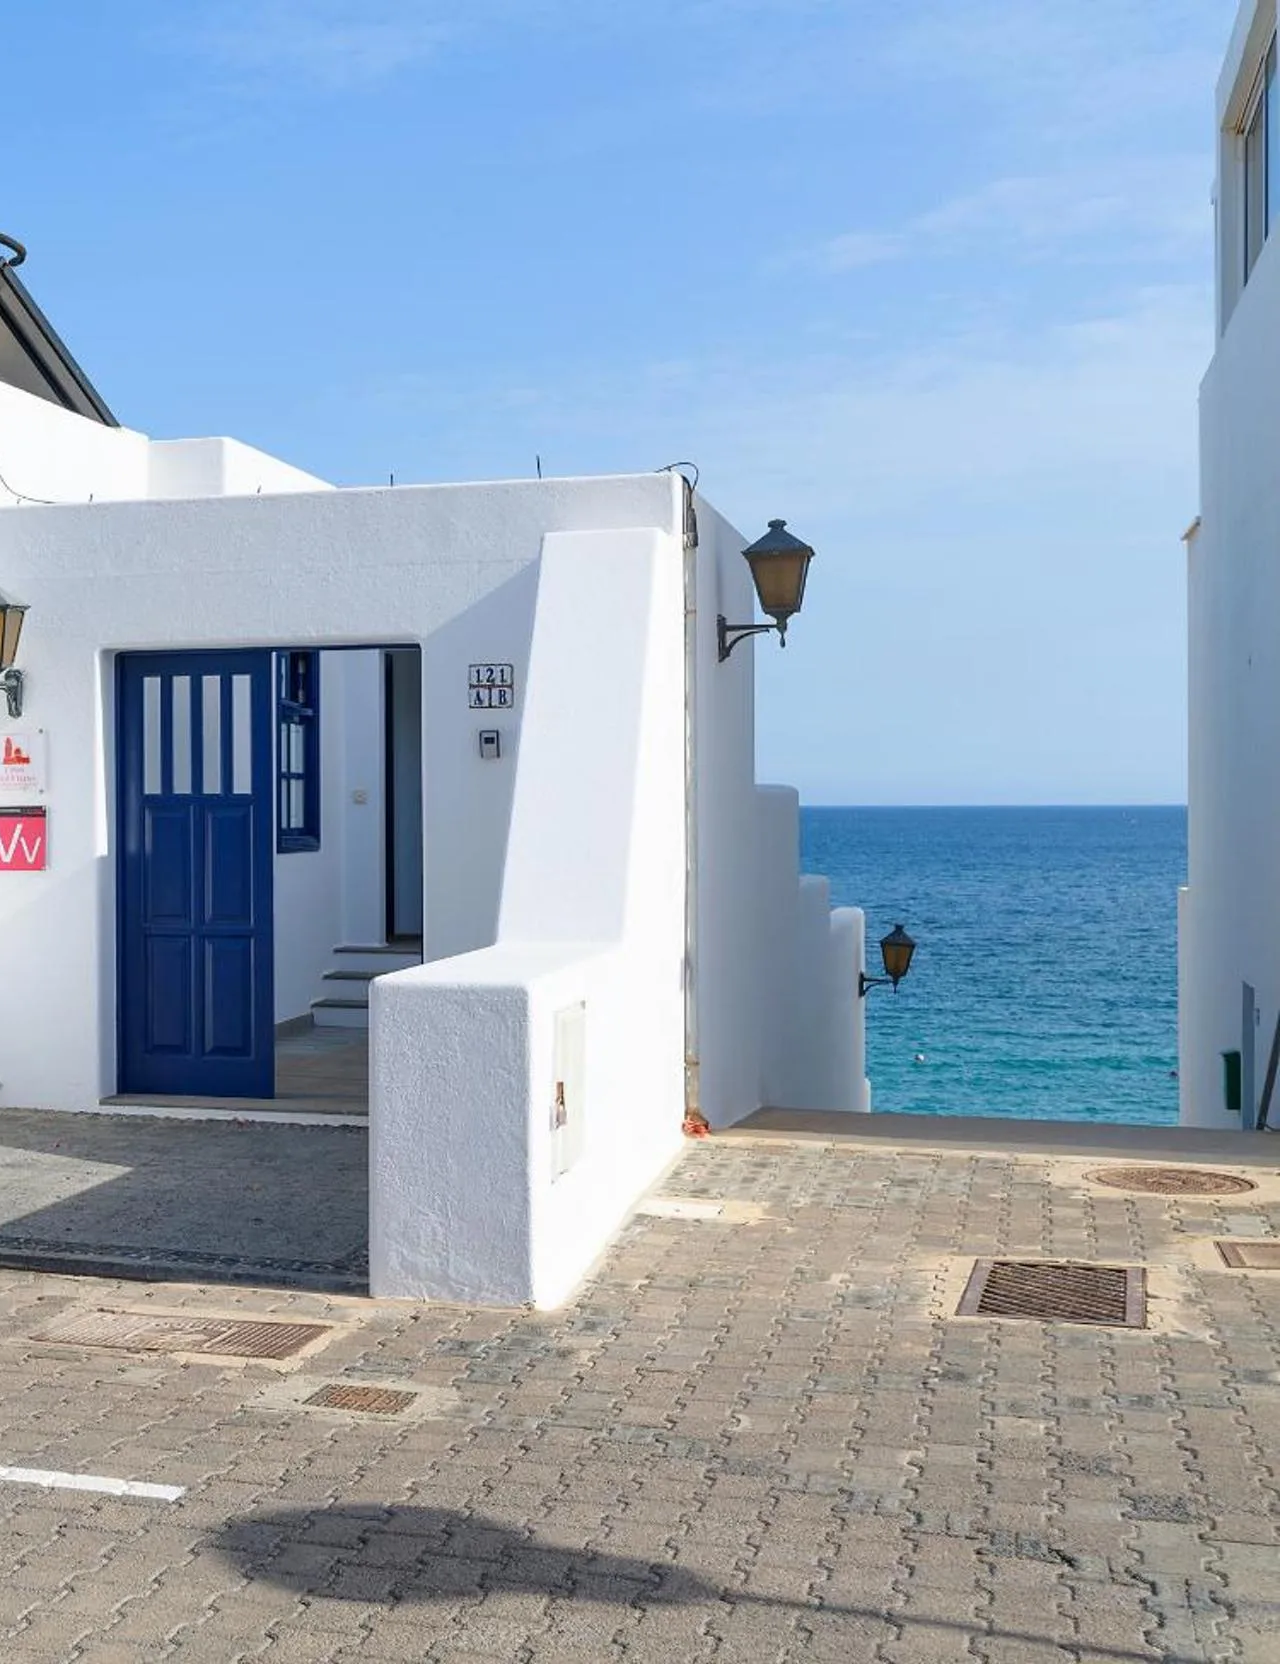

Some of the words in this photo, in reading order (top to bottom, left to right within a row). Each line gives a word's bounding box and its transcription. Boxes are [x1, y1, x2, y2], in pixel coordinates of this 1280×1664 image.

[475, 667, 507, 683] 121
[474, 689, 483, 705] A
[498, 689, 508, 705] B
